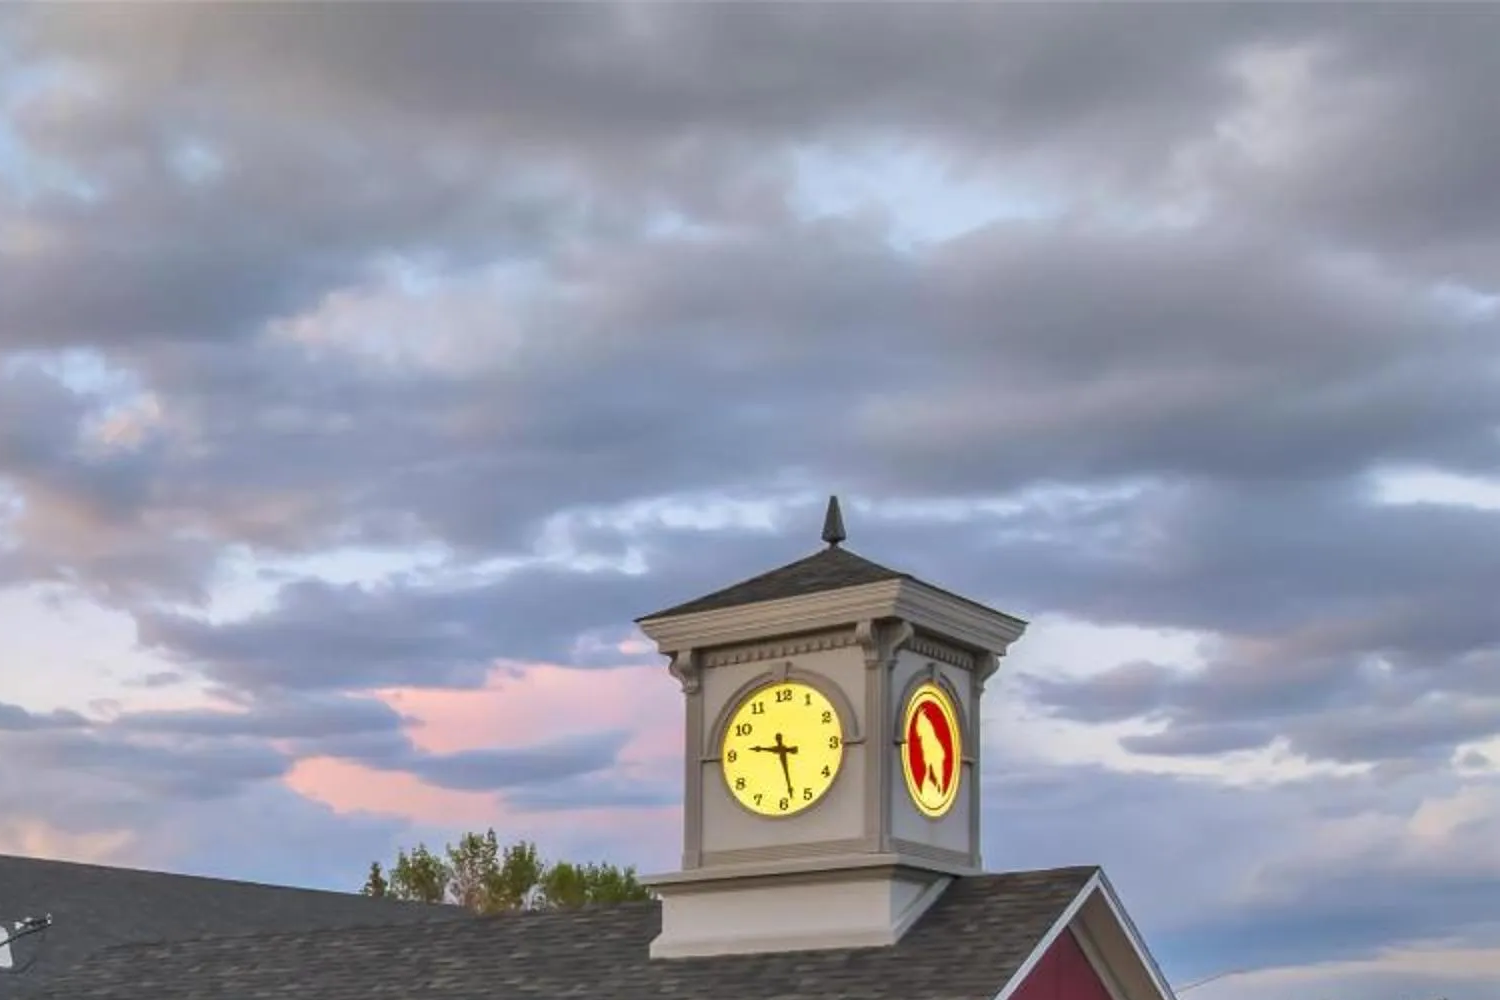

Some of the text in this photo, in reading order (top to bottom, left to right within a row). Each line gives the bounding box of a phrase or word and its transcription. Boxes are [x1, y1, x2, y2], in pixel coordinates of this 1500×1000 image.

[775, 689, 793, 703] 12
[804, 693, 811, 706] 1
[751, 701, 765, 715] 11
[821, 711, 832, 724] 2
[735, 723, 753, 737] 10
[829, 735, 839, 750] 3
[727, 750, 737, 763] 9
[821, 764, 831, 778] 4
[735, 777, 746, 791] 8
[753, 793, 763, 806] 7
[803, 787, 813, 801] 5
[779, 797, 789, 811] 6
